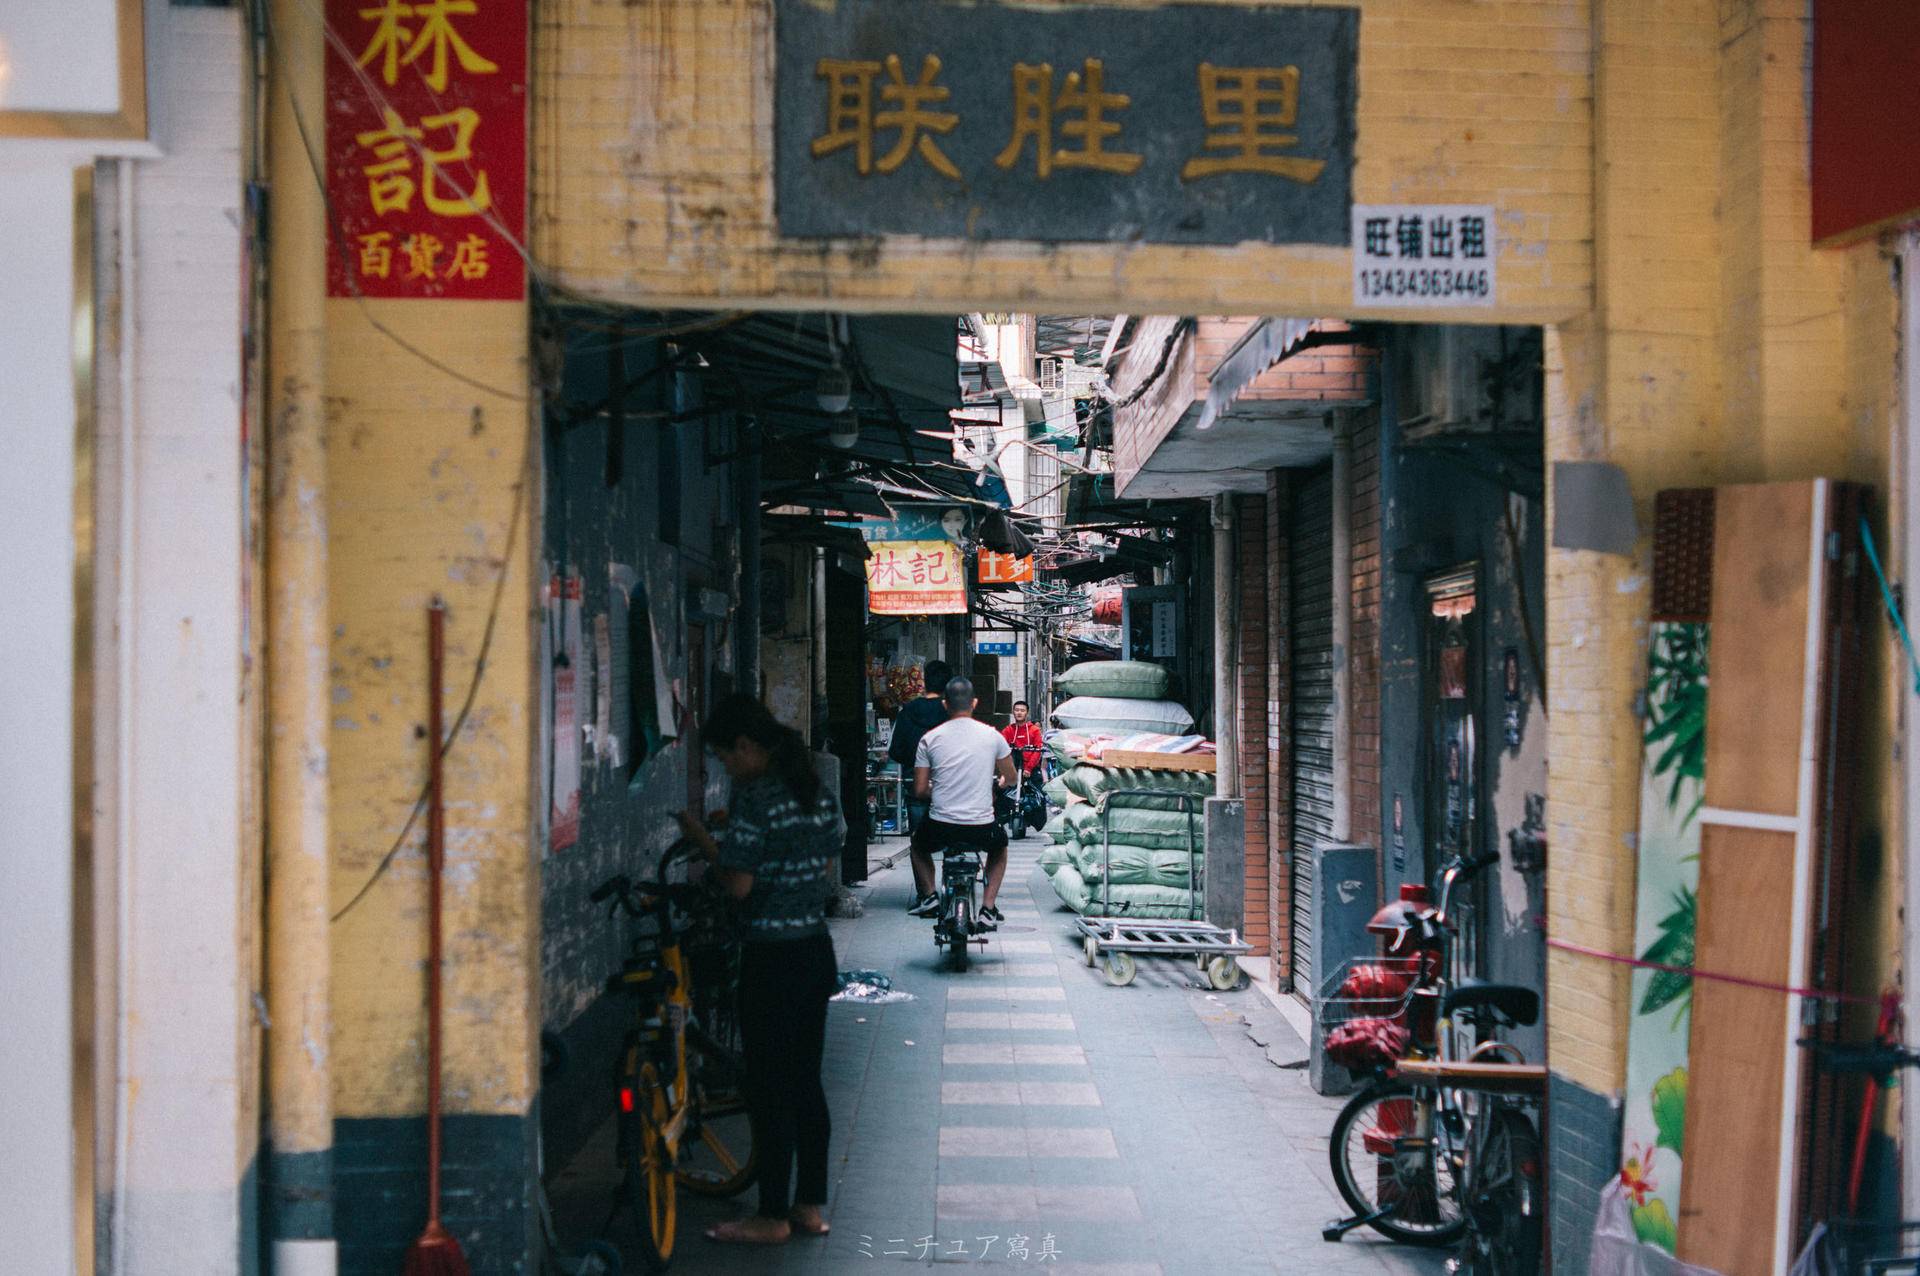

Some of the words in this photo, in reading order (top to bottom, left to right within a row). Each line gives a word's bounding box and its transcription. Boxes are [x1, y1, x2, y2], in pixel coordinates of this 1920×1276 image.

[356, 0, 499, 217] 林記
[811, 53, 1328, 184] 联胜里
[357, 231, 490, 281] 百貨店
[1365, 214, 1486, 259] 旺铺出租
[1360, 269, 1489, 296] 13434363446
[868, 550, 949, 587] 林記
[981, 550, 1030, 580] 士多
